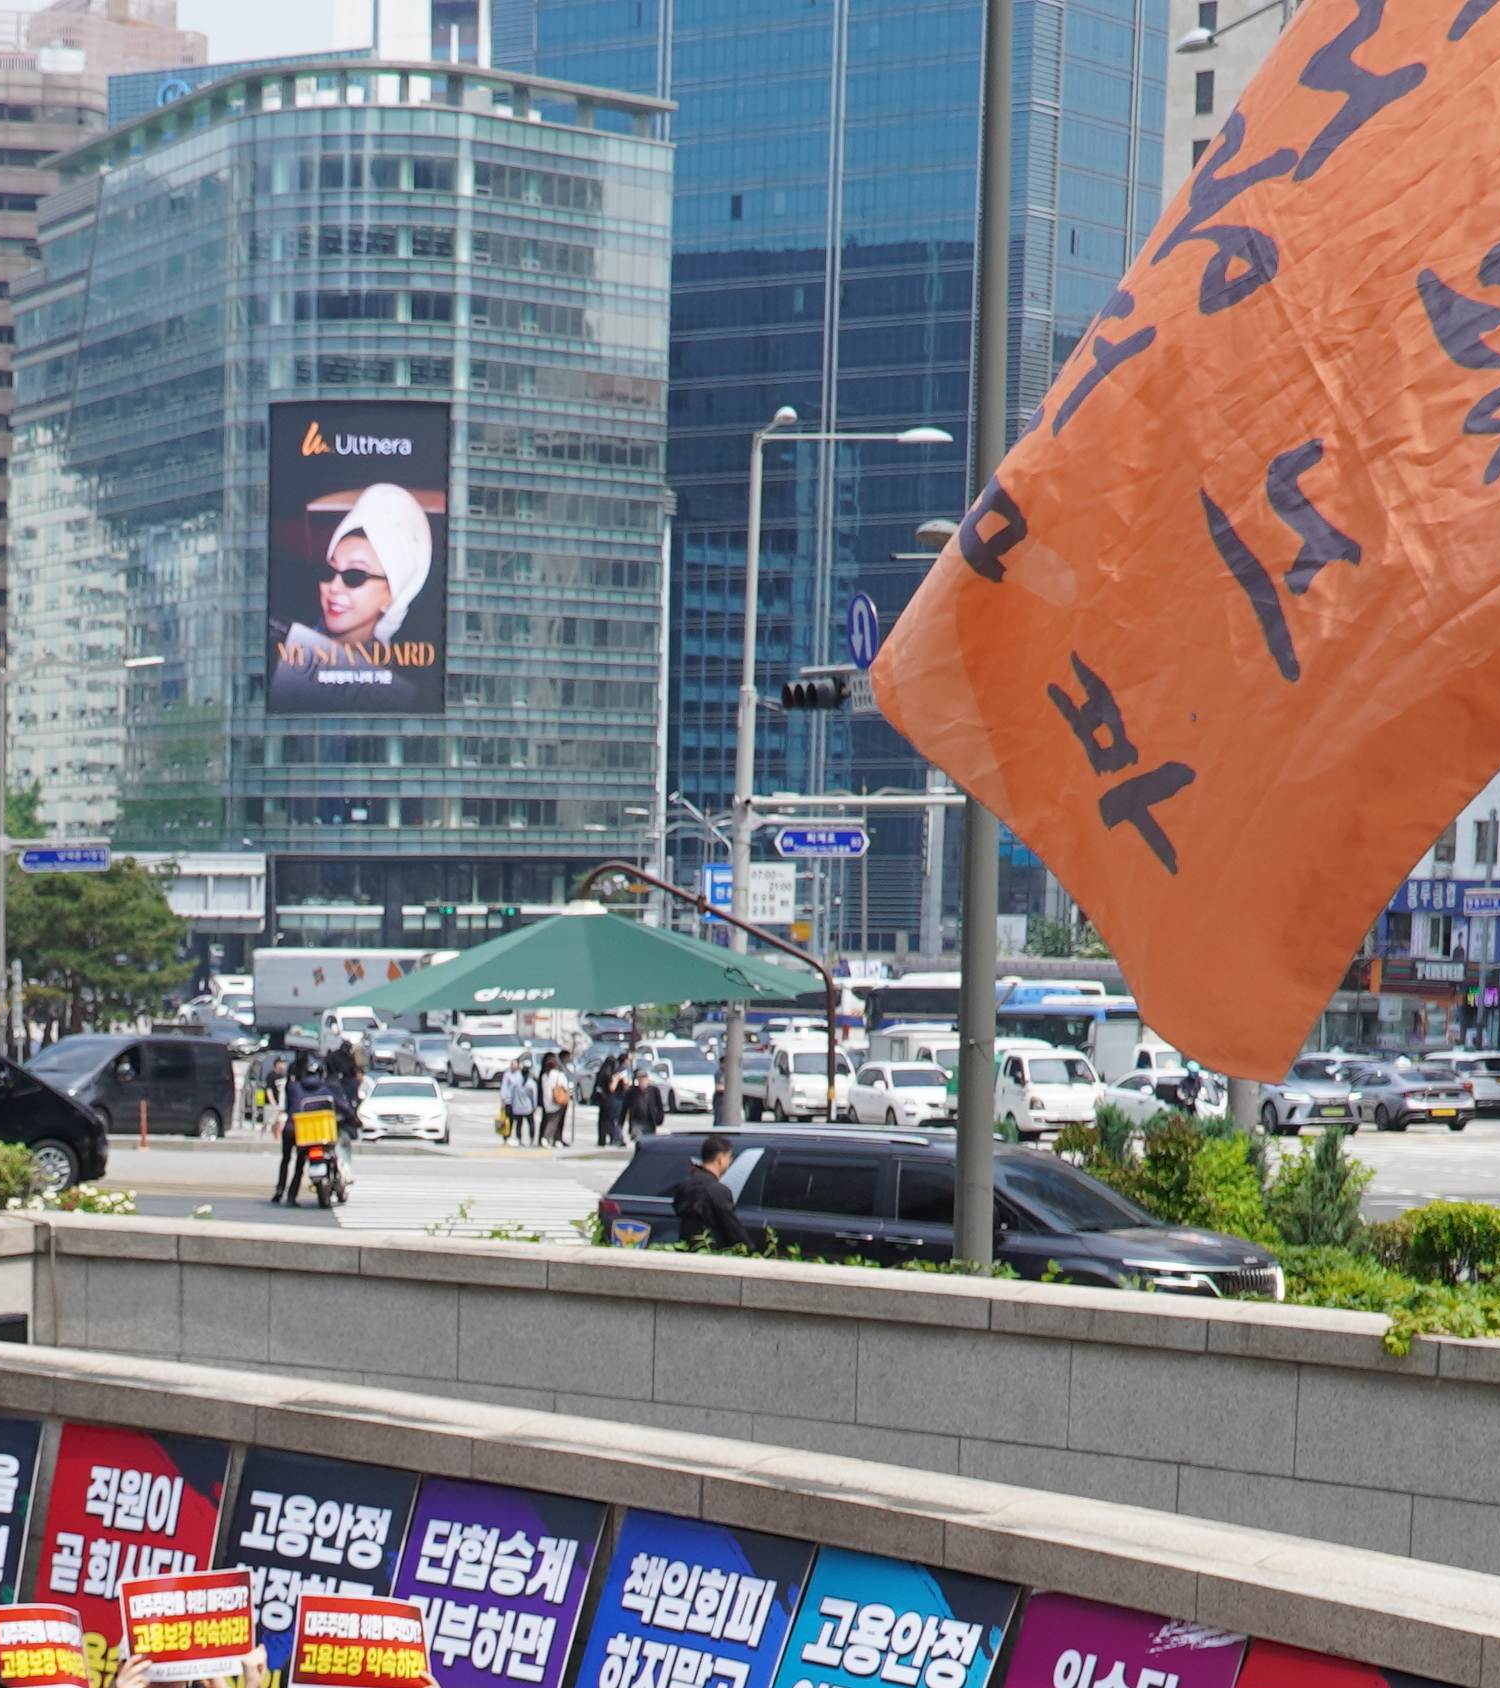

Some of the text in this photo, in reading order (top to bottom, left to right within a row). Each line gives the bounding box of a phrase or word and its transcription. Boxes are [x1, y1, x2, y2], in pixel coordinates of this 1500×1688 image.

[335, 433, 412, 455] Ulthera
[278, 641, 435, 668] MY STANDARD
[86, 1465, 184, 1537] 직원이
[241, 1489, 394, 1570] 고용안정
[50, 1531, 85, 1595] 곧
[415, 1518, 580, 1604] 단협승계
[621, 1551, 777, 1648] 책임회피
